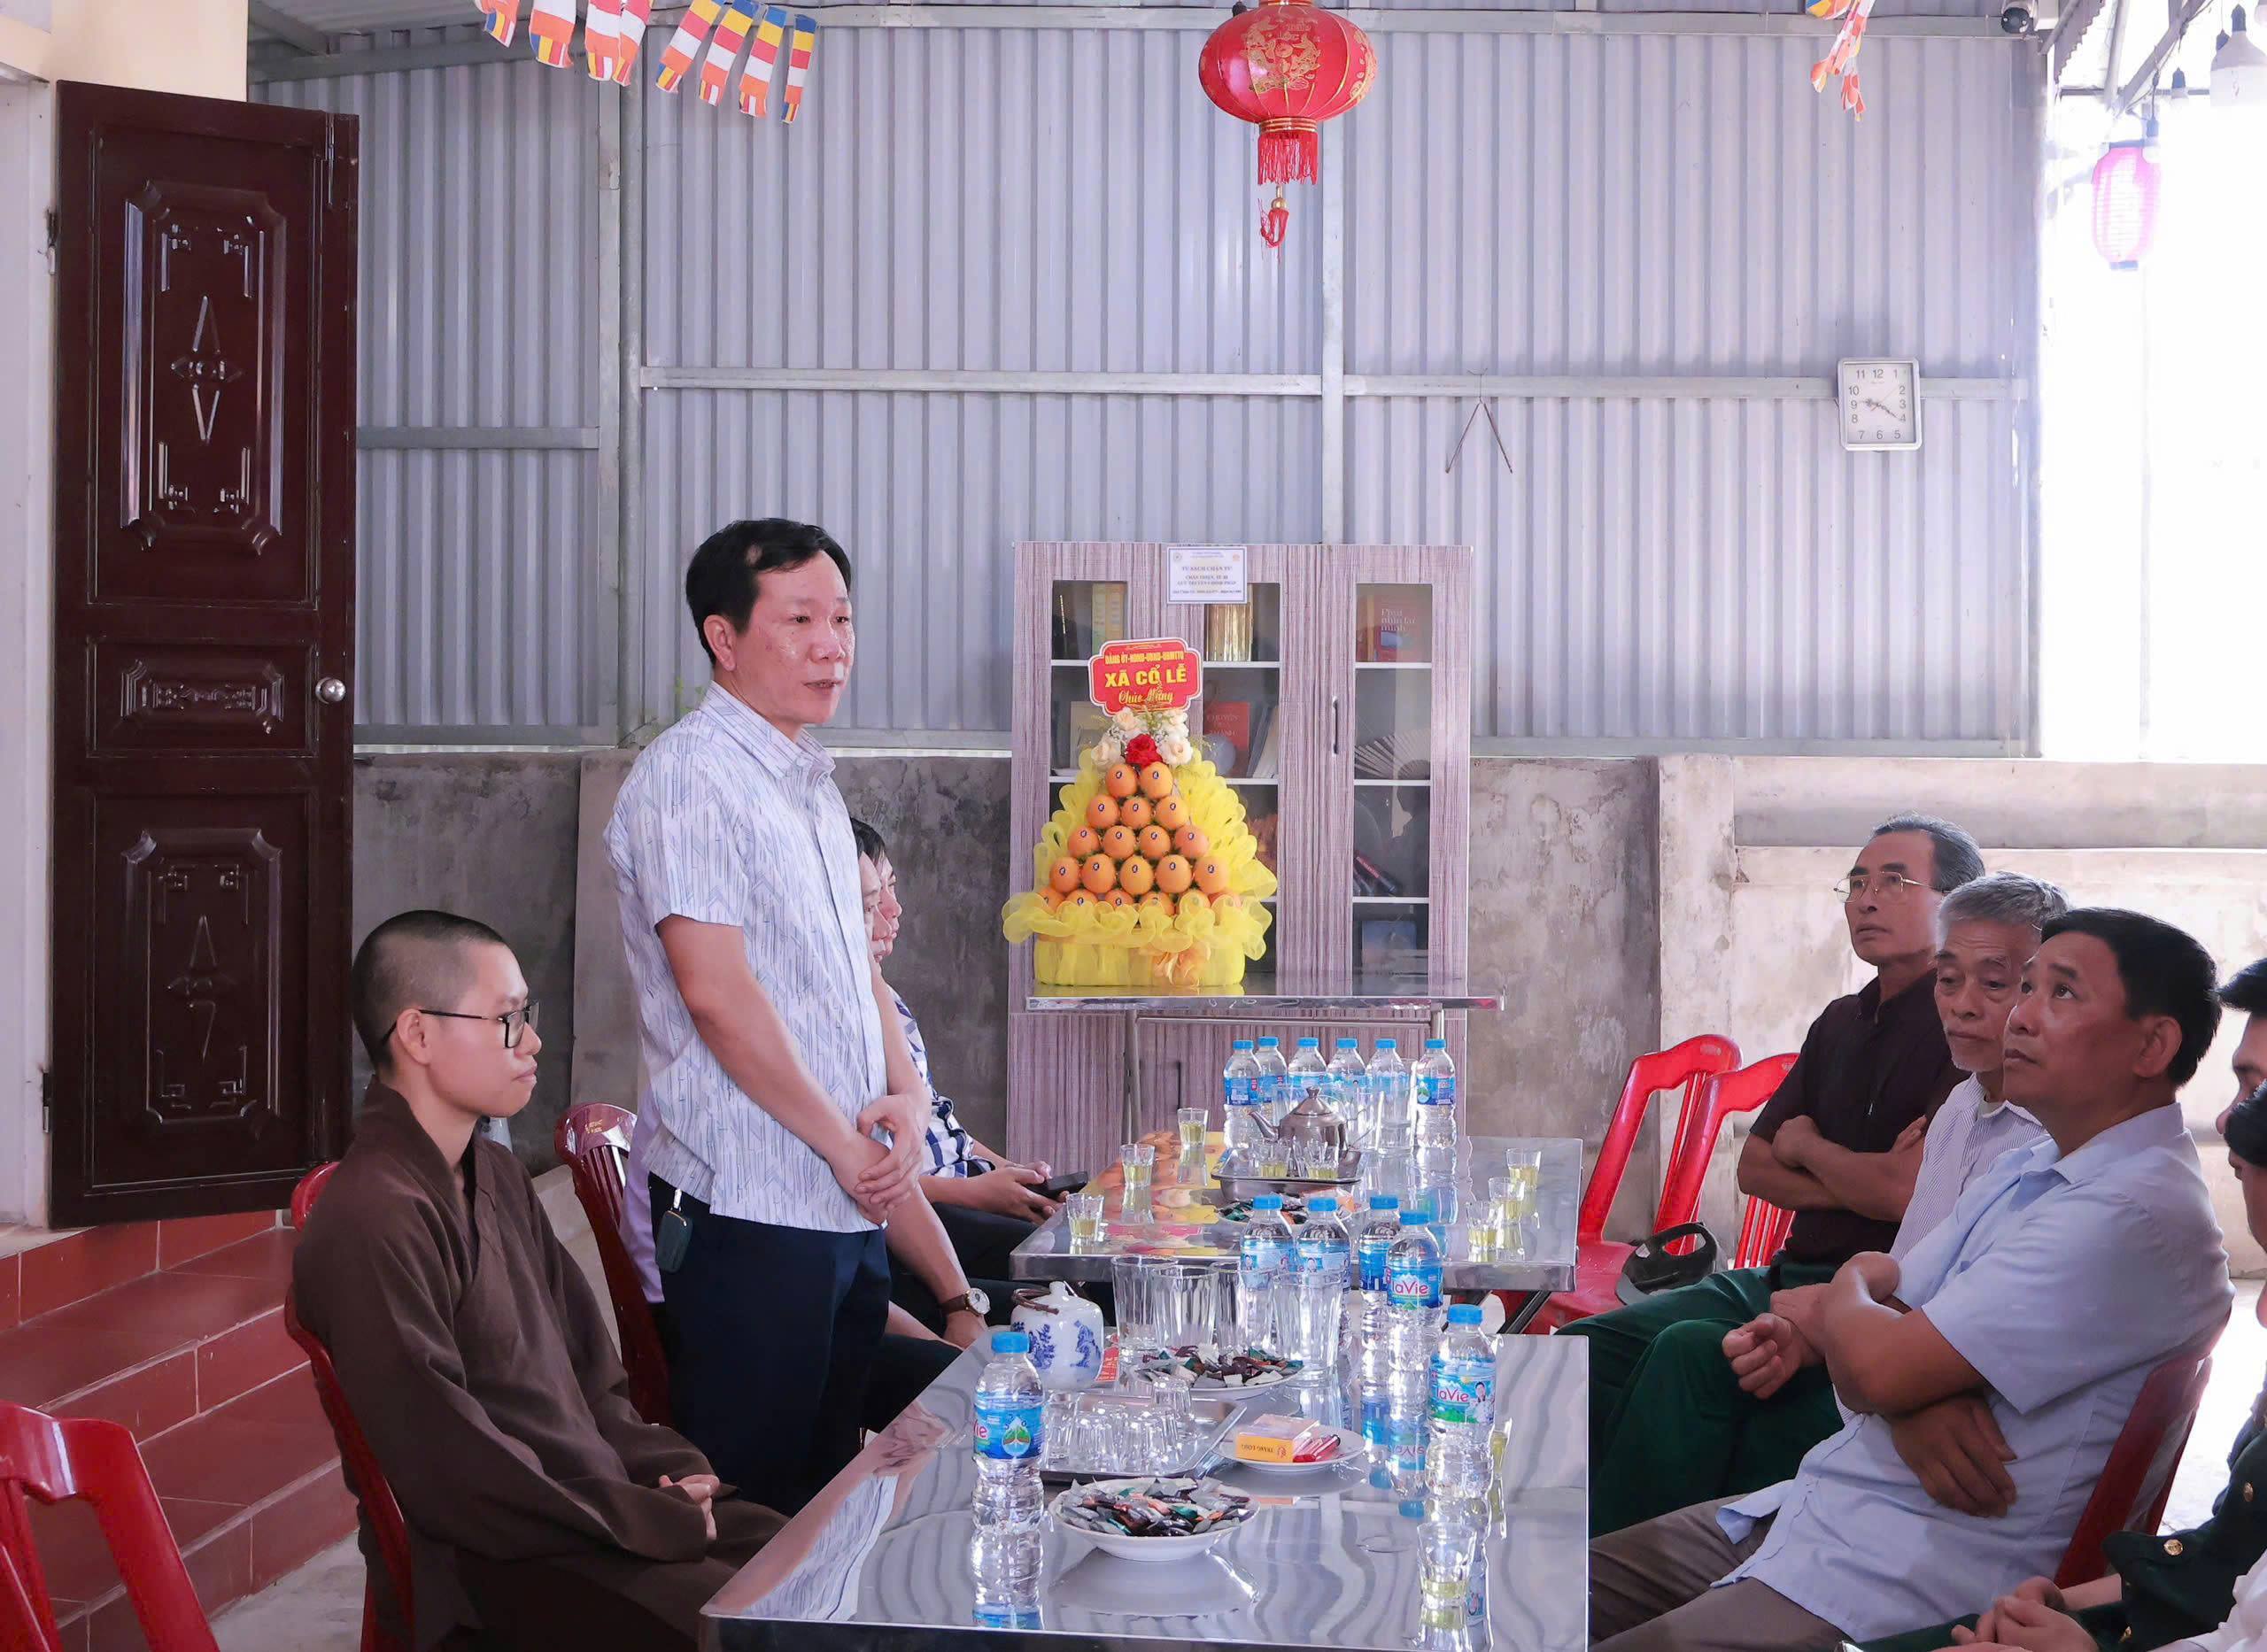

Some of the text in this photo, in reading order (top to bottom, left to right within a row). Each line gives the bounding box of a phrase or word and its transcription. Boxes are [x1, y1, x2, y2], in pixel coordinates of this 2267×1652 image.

[1856, 369, 1865, 379] 11
[1872, 368, 1884, 379] 12
[1893, 369, 1898, 379] 1
[1848, 385, 1860, 396] 10
[1899, 385, 1906, 395] 2
[1851, 400, 1858, 409] 9
[1899, 399, 1907, 409] 3
[1852, 413, 1858, 423] 8
[1899, 413, 1907, 422] 4
[1858, 430, 1865, 440] 7
[1876, 429, 1884, 440] 6
[1894, 429, 1901, 439] 5
[1104, 663, 1188, 688] XÃ CỔ LỄ
[1392, 1280, 1428, 1294] laVie
[1436, 1386, 1469, 1402] laVie
